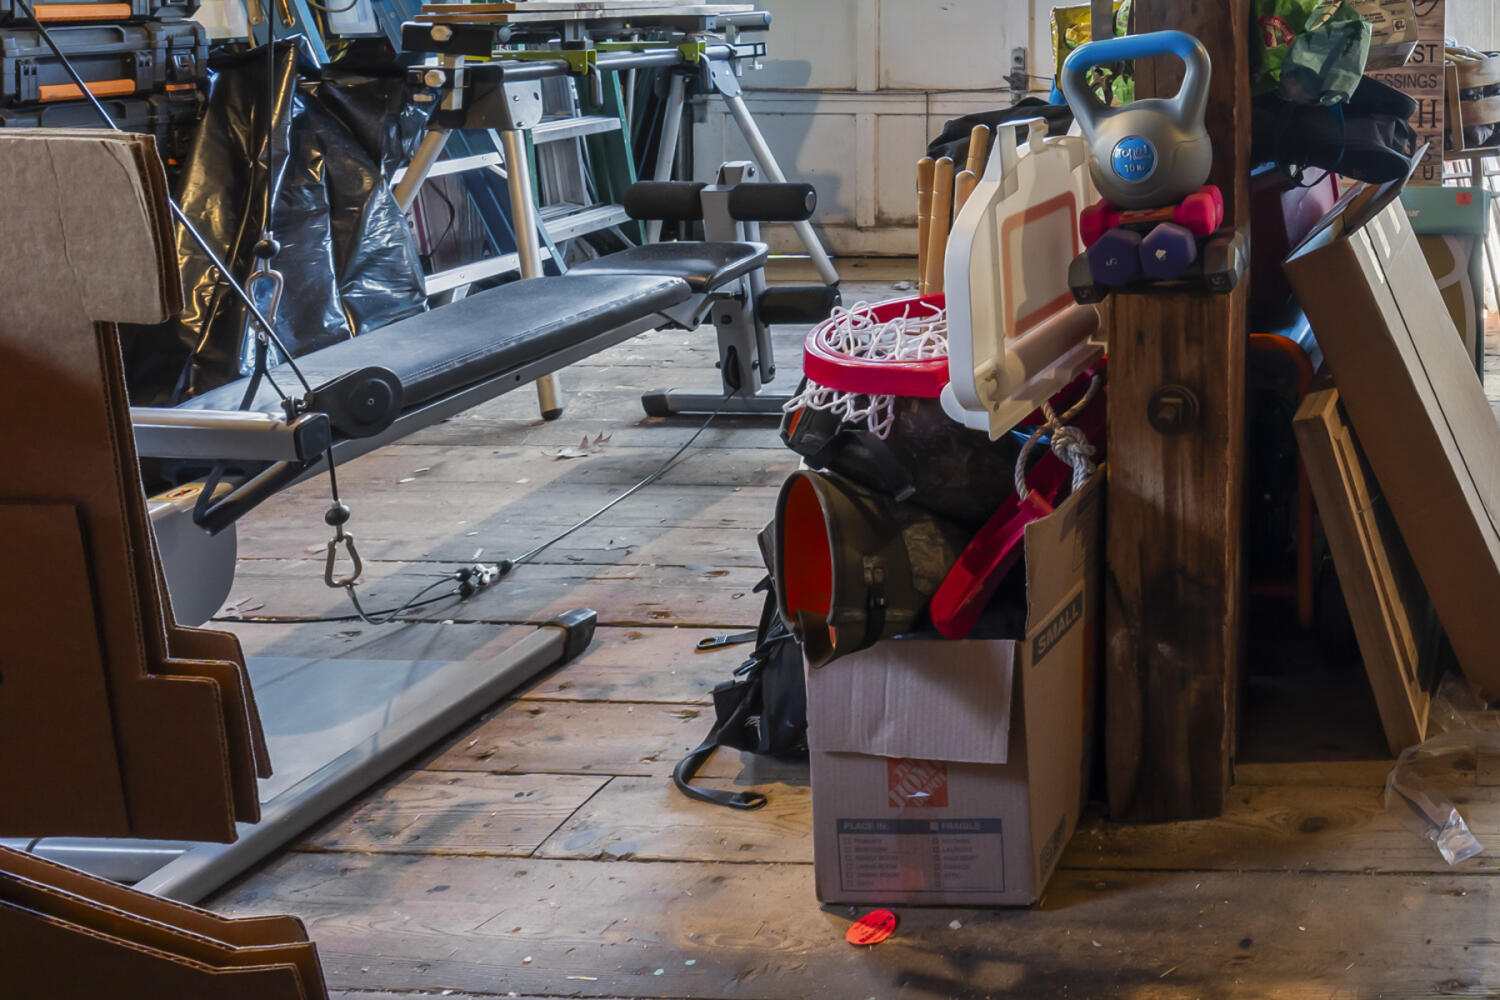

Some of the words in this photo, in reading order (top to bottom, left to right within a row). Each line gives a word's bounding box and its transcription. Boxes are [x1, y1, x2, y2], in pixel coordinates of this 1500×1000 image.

[1409, 43, 1439, 63] ST
[1037, 602, 1079, 655] SMALL
[889, 761, 937, 808] HOM
